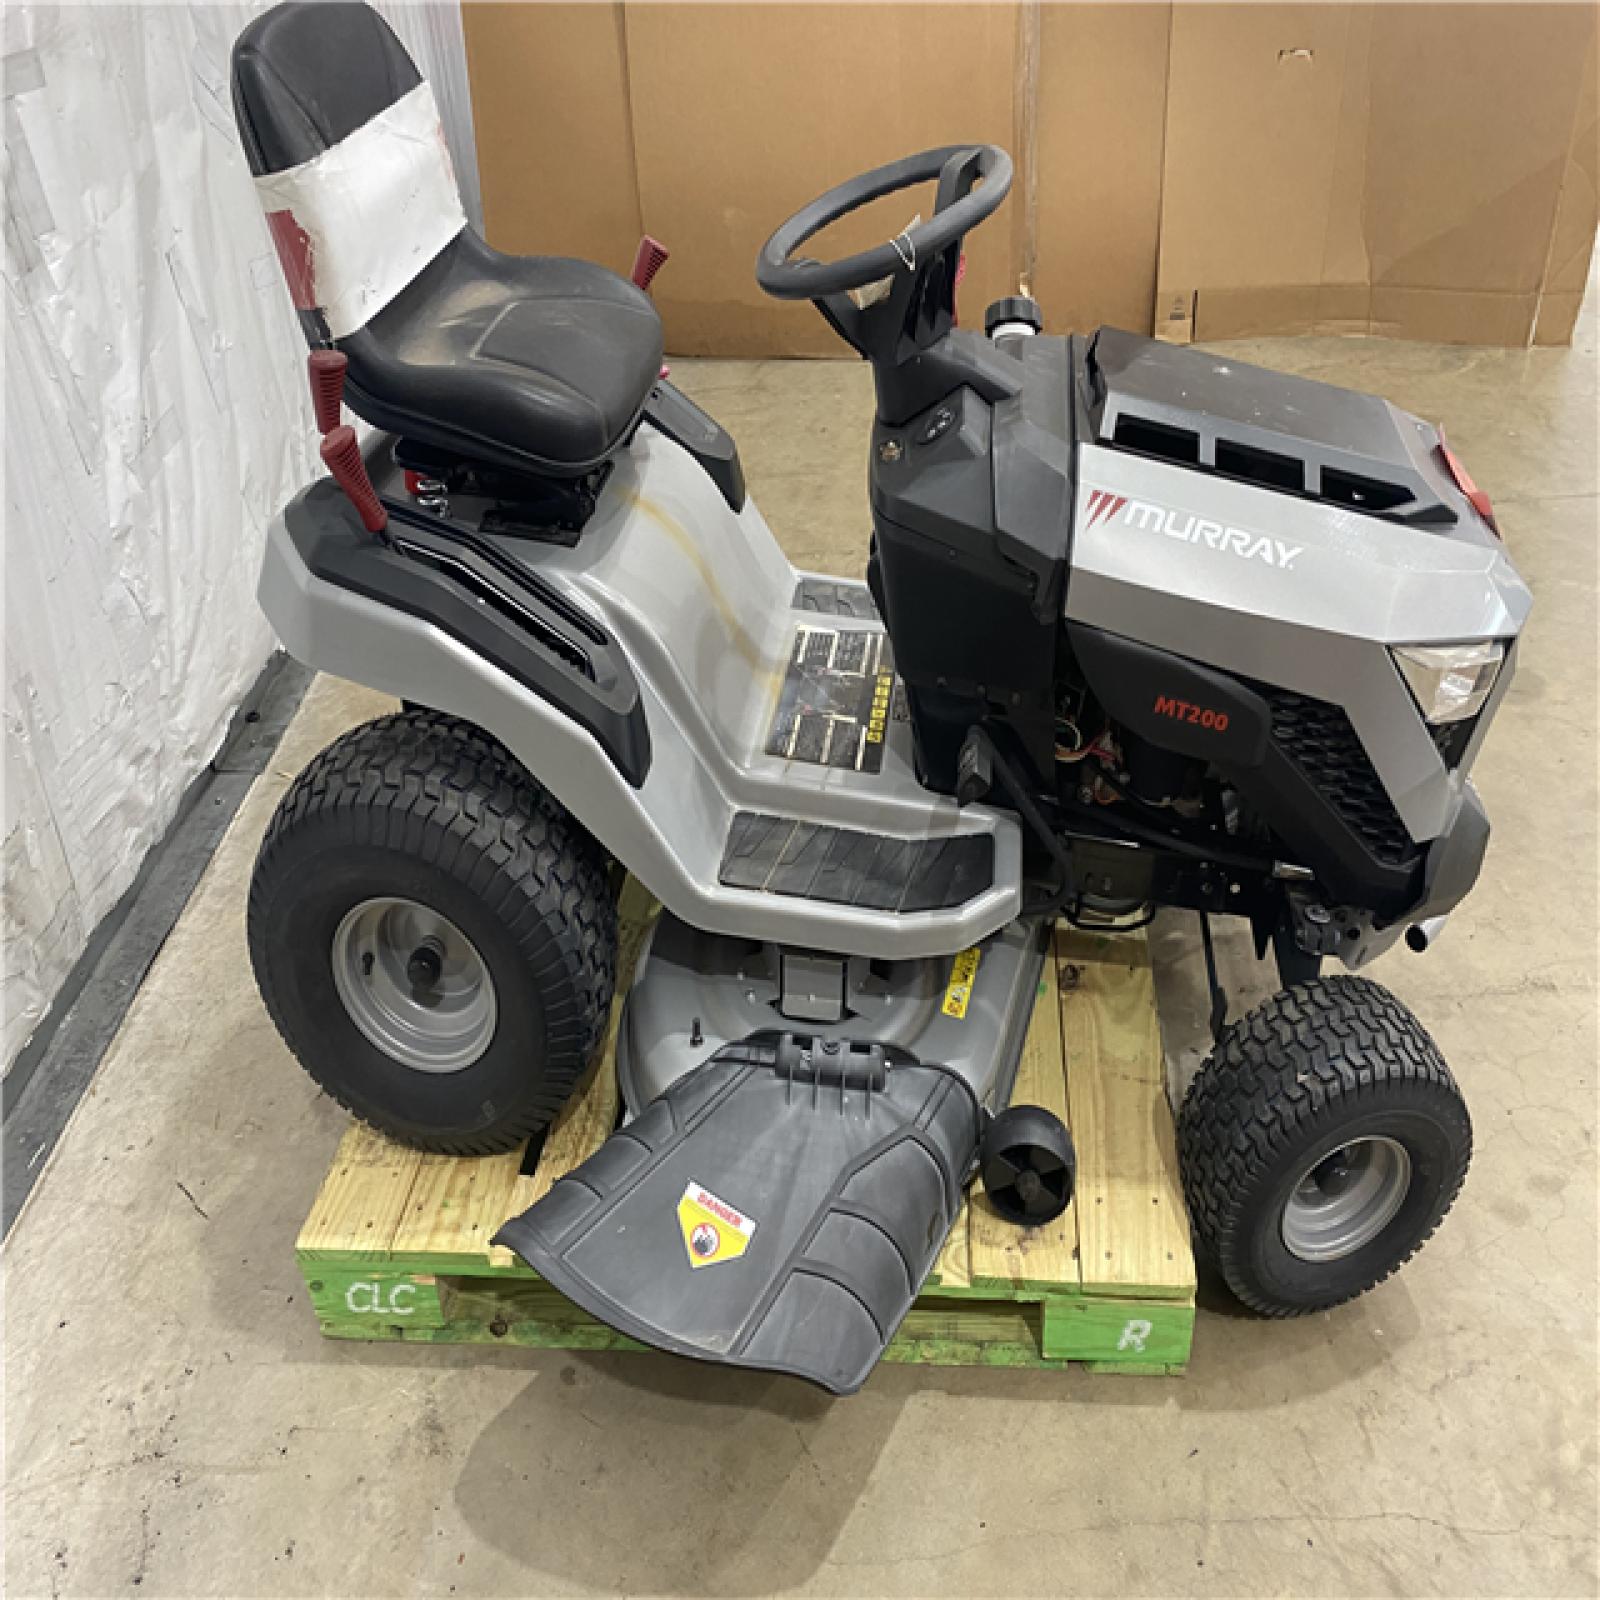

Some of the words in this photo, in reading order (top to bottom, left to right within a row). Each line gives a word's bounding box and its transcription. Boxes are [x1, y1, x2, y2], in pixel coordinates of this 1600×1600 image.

[1124, 500, 1304, 569] MURRAY
[1154, 695, 1229, 731] MT200
[697, 1191, 743, 1227] DANGER
[345, 1282, 416, 1315] CLC
[1117, 1319, 1153, 1353] R
